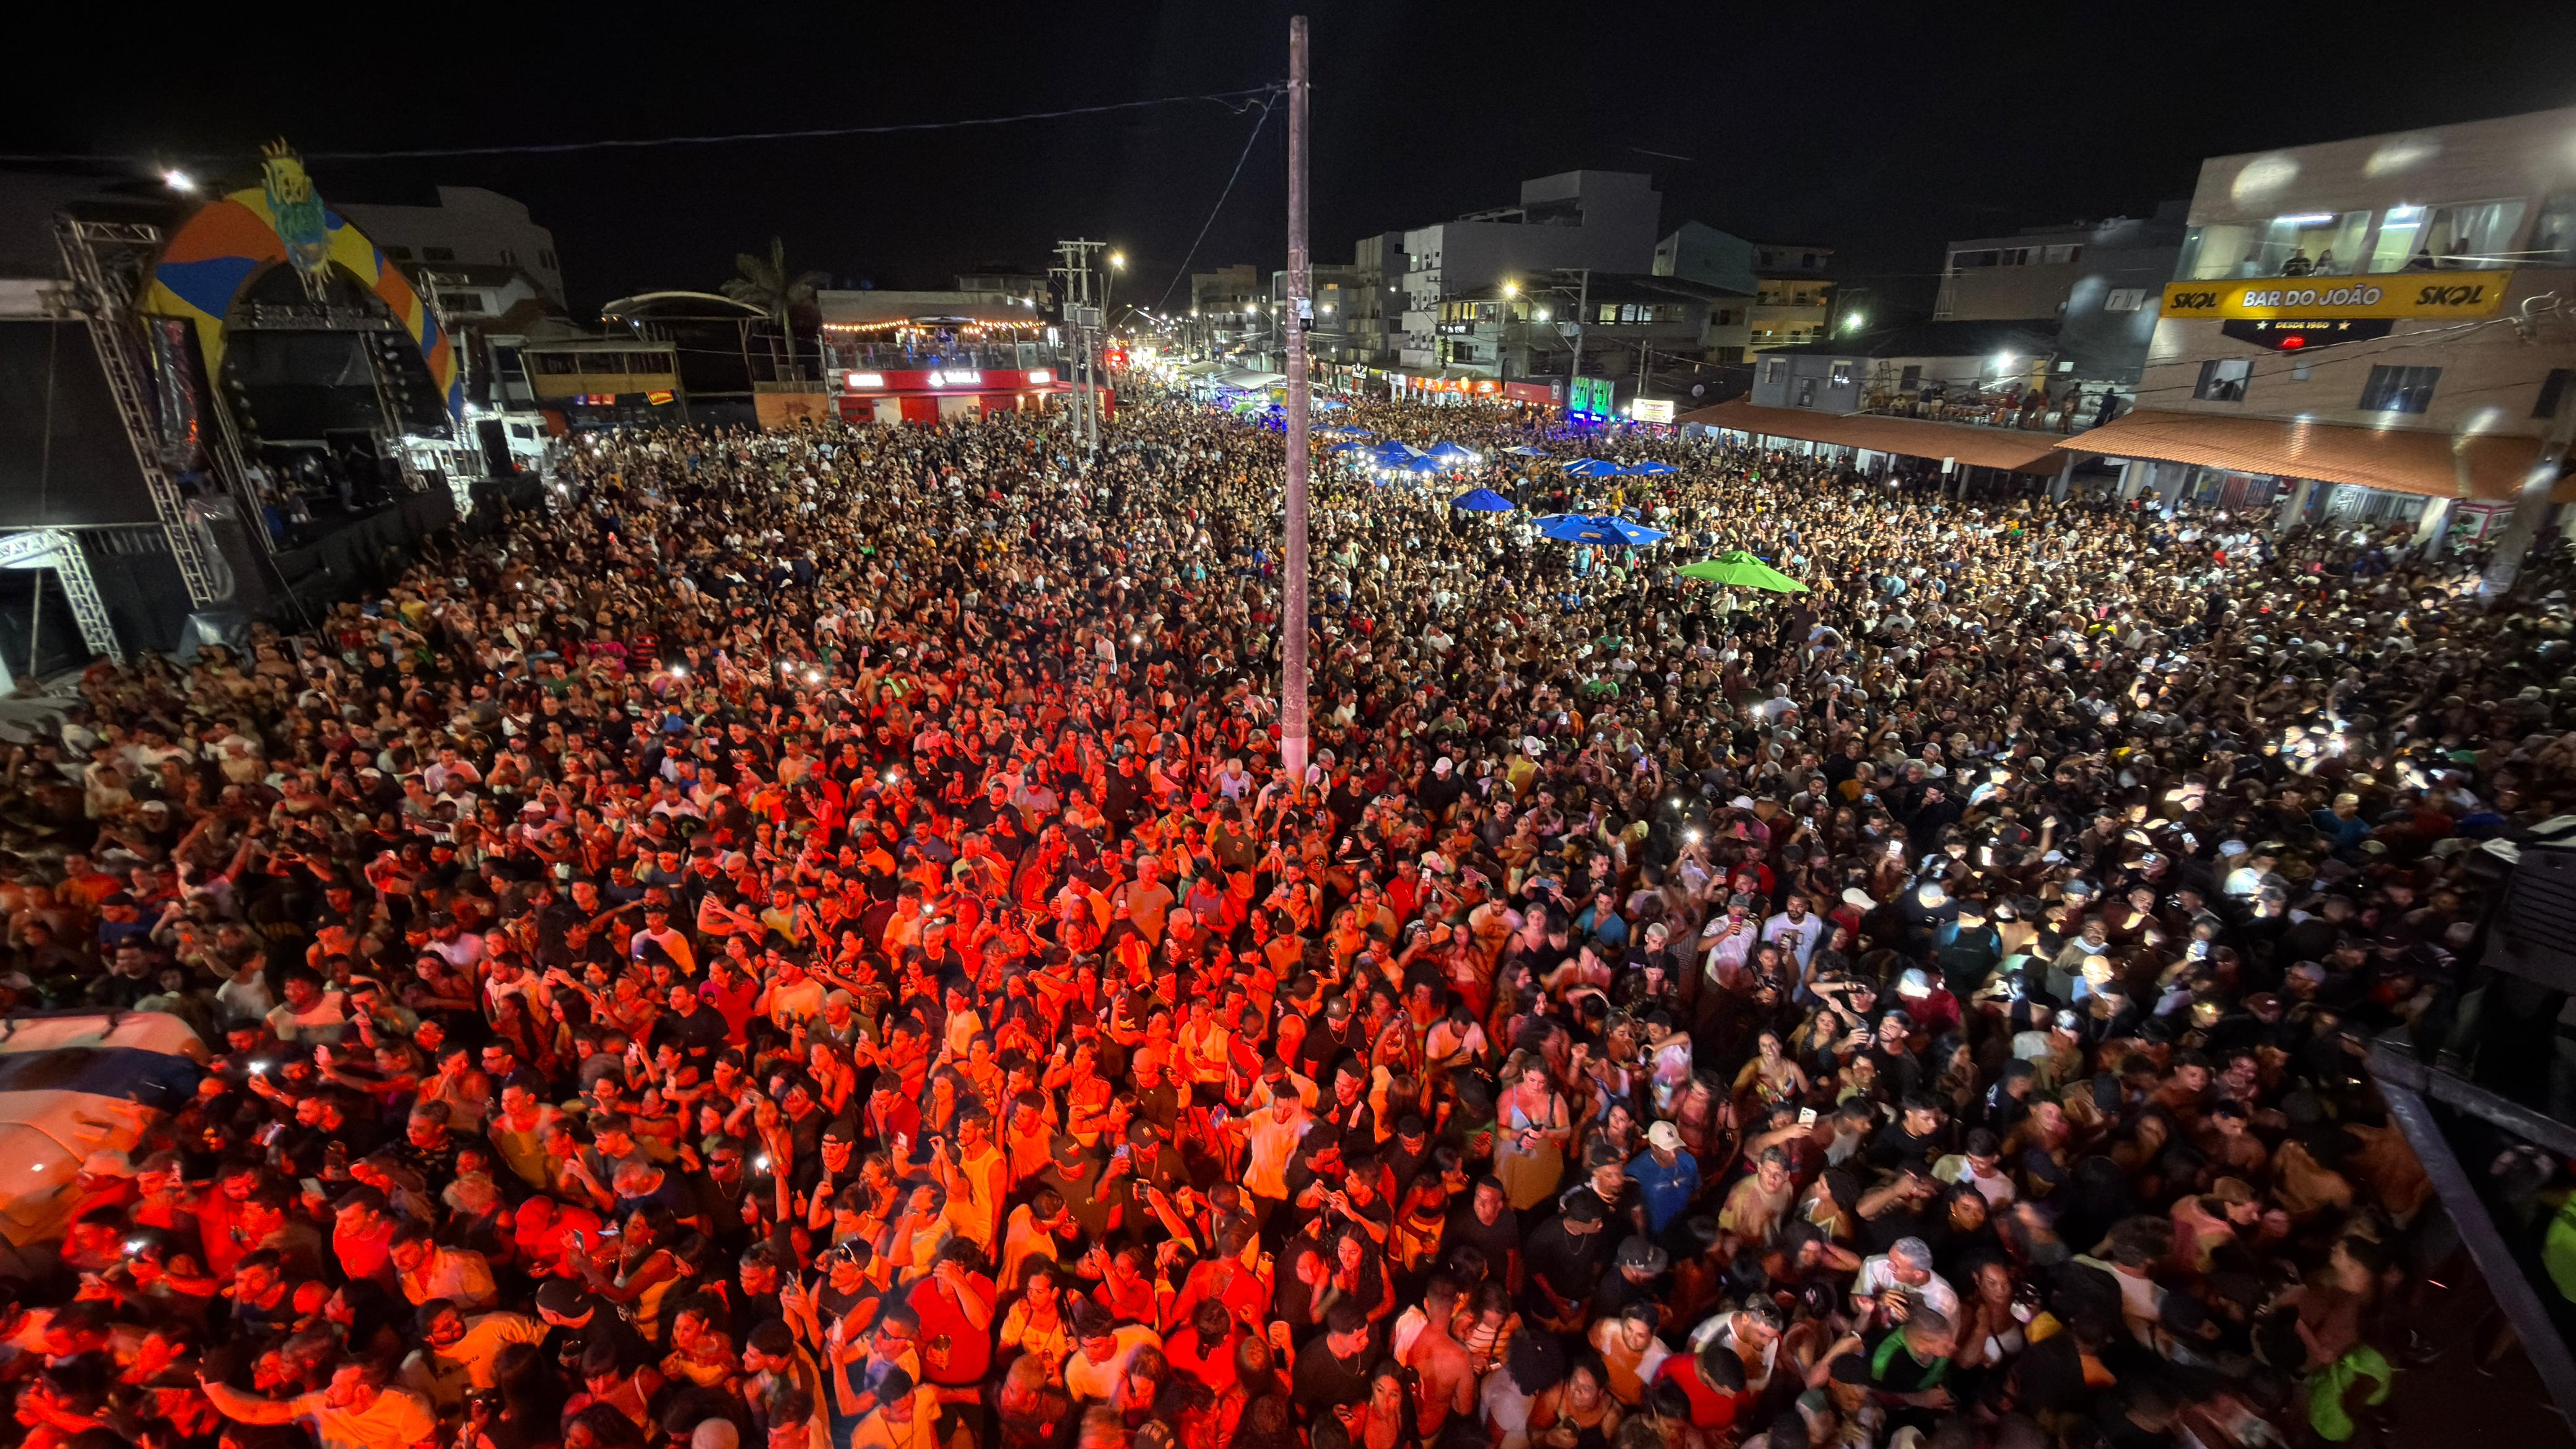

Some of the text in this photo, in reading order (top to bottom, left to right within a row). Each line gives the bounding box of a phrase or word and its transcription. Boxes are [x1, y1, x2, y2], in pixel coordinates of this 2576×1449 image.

[2170, 292, 2217, 310] SKOL
[2242, 283, 2382, 307] BAR DO JOÃO
[2416, 285, 2484, 307] SKOL
[2274, 321, 2305, 329] DESDE
